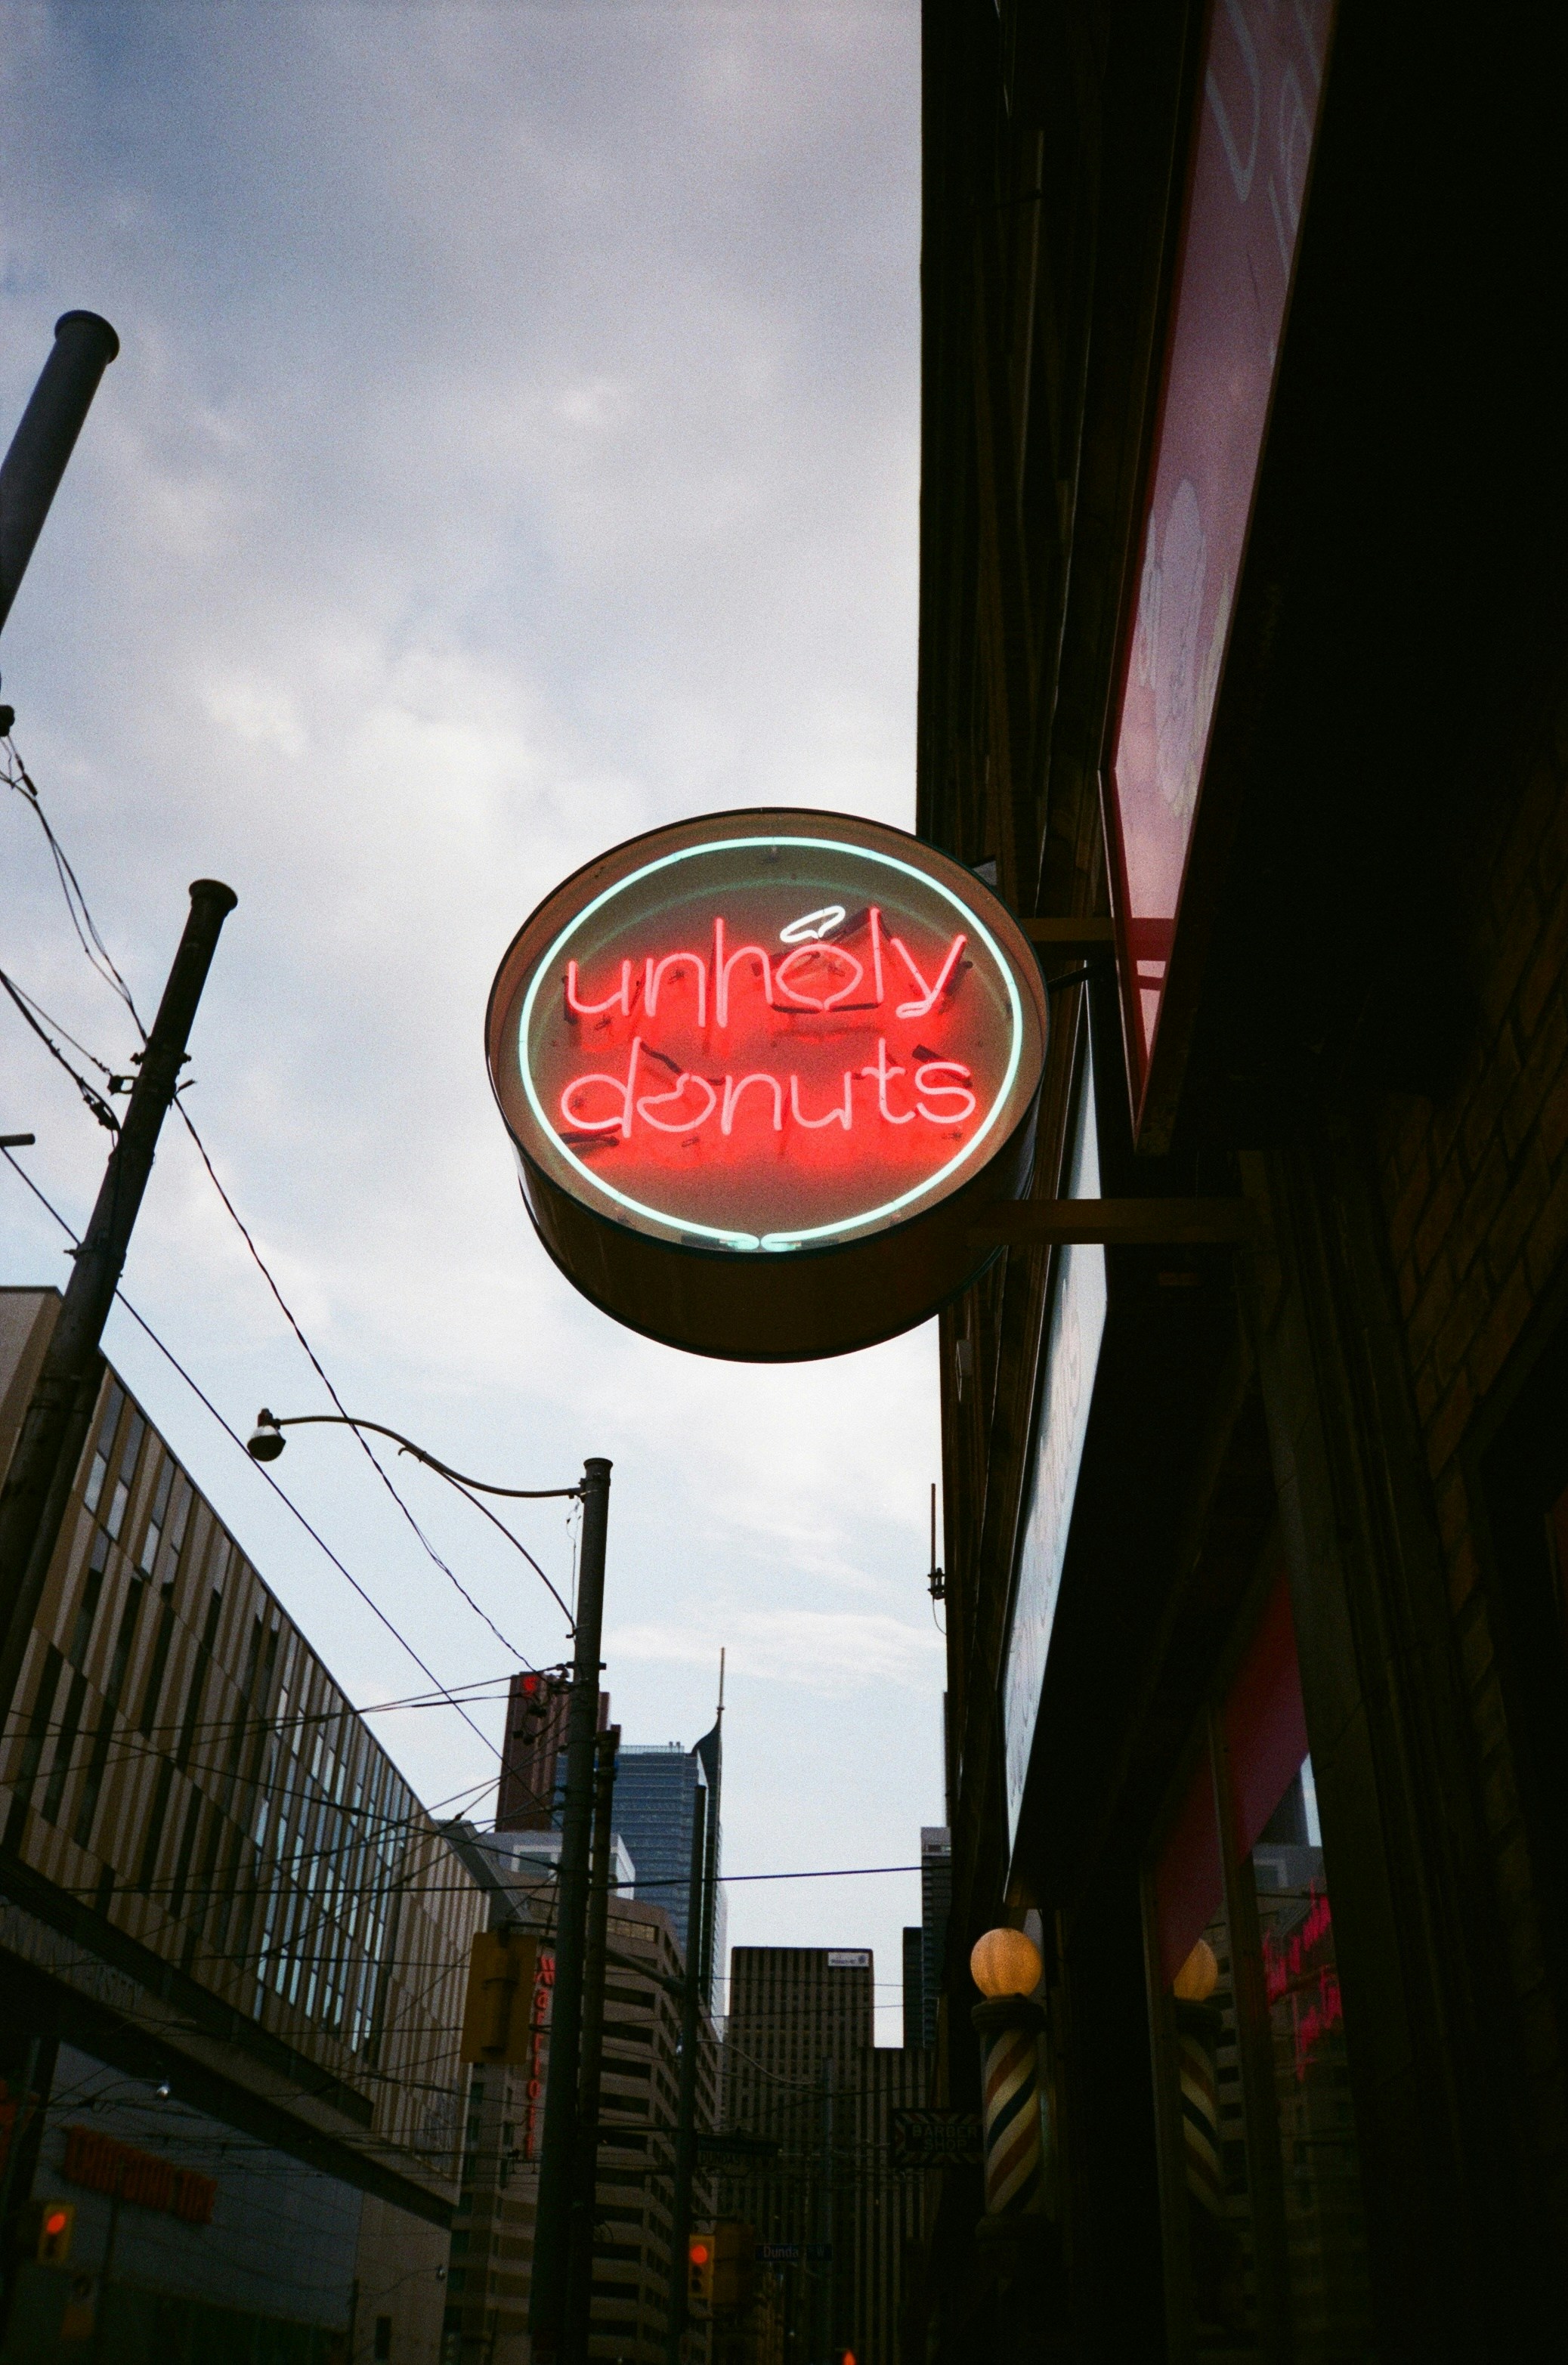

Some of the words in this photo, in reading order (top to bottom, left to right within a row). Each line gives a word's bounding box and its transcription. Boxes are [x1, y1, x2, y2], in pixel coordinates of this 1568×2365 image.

[567, 907, 967, 1028] unholy
[561, 1037, 976, 1138] donuts
[912, 2124, 977, 2139] BARBER
[923, 2138, 967, 2152] SHOP
[763, 2245, 803, 2258] Dunda
